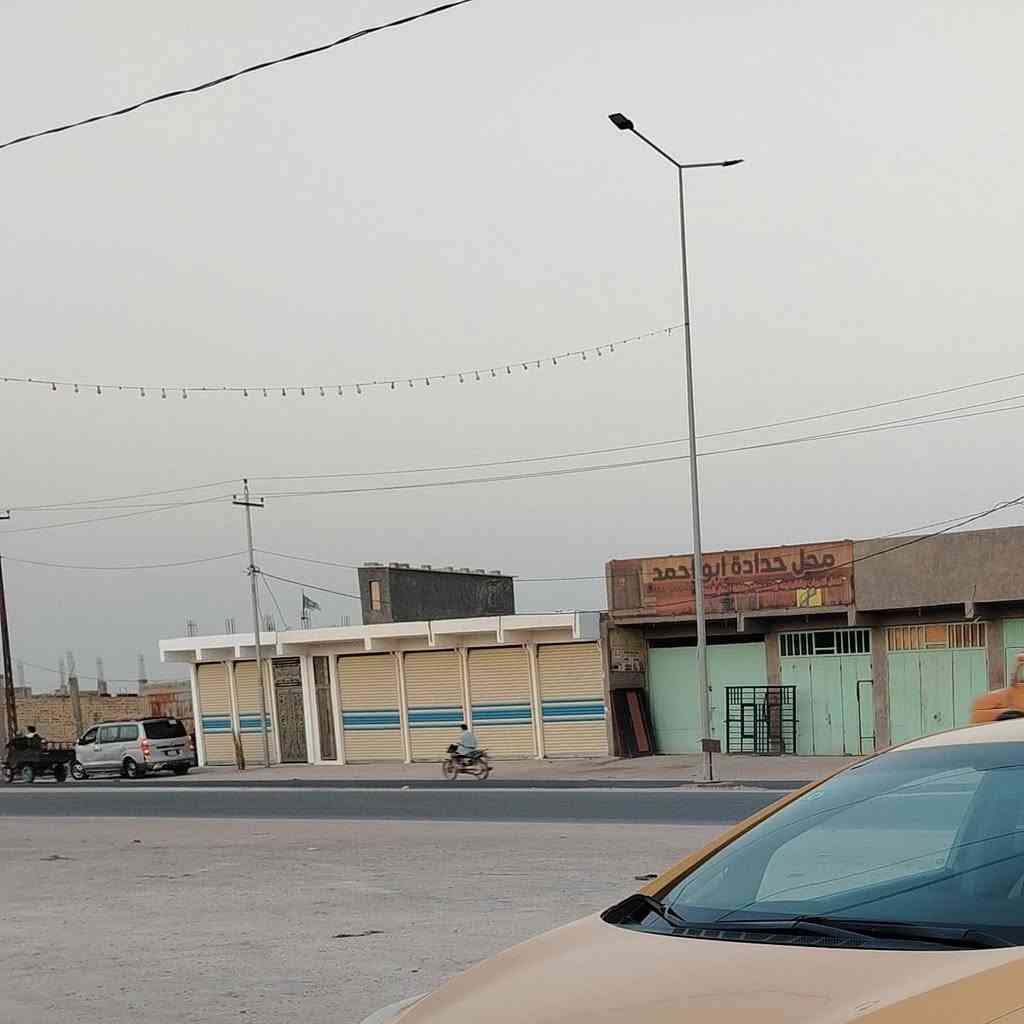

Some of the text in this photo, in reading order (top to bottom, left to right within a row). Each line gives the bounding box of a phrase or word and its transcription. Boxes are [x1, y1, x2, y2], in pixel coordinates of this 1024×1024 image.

[701, 557, 726, 582] ابو
[731, 551, 787, 577] حدادة
[791, 549, 836, 576] محل
